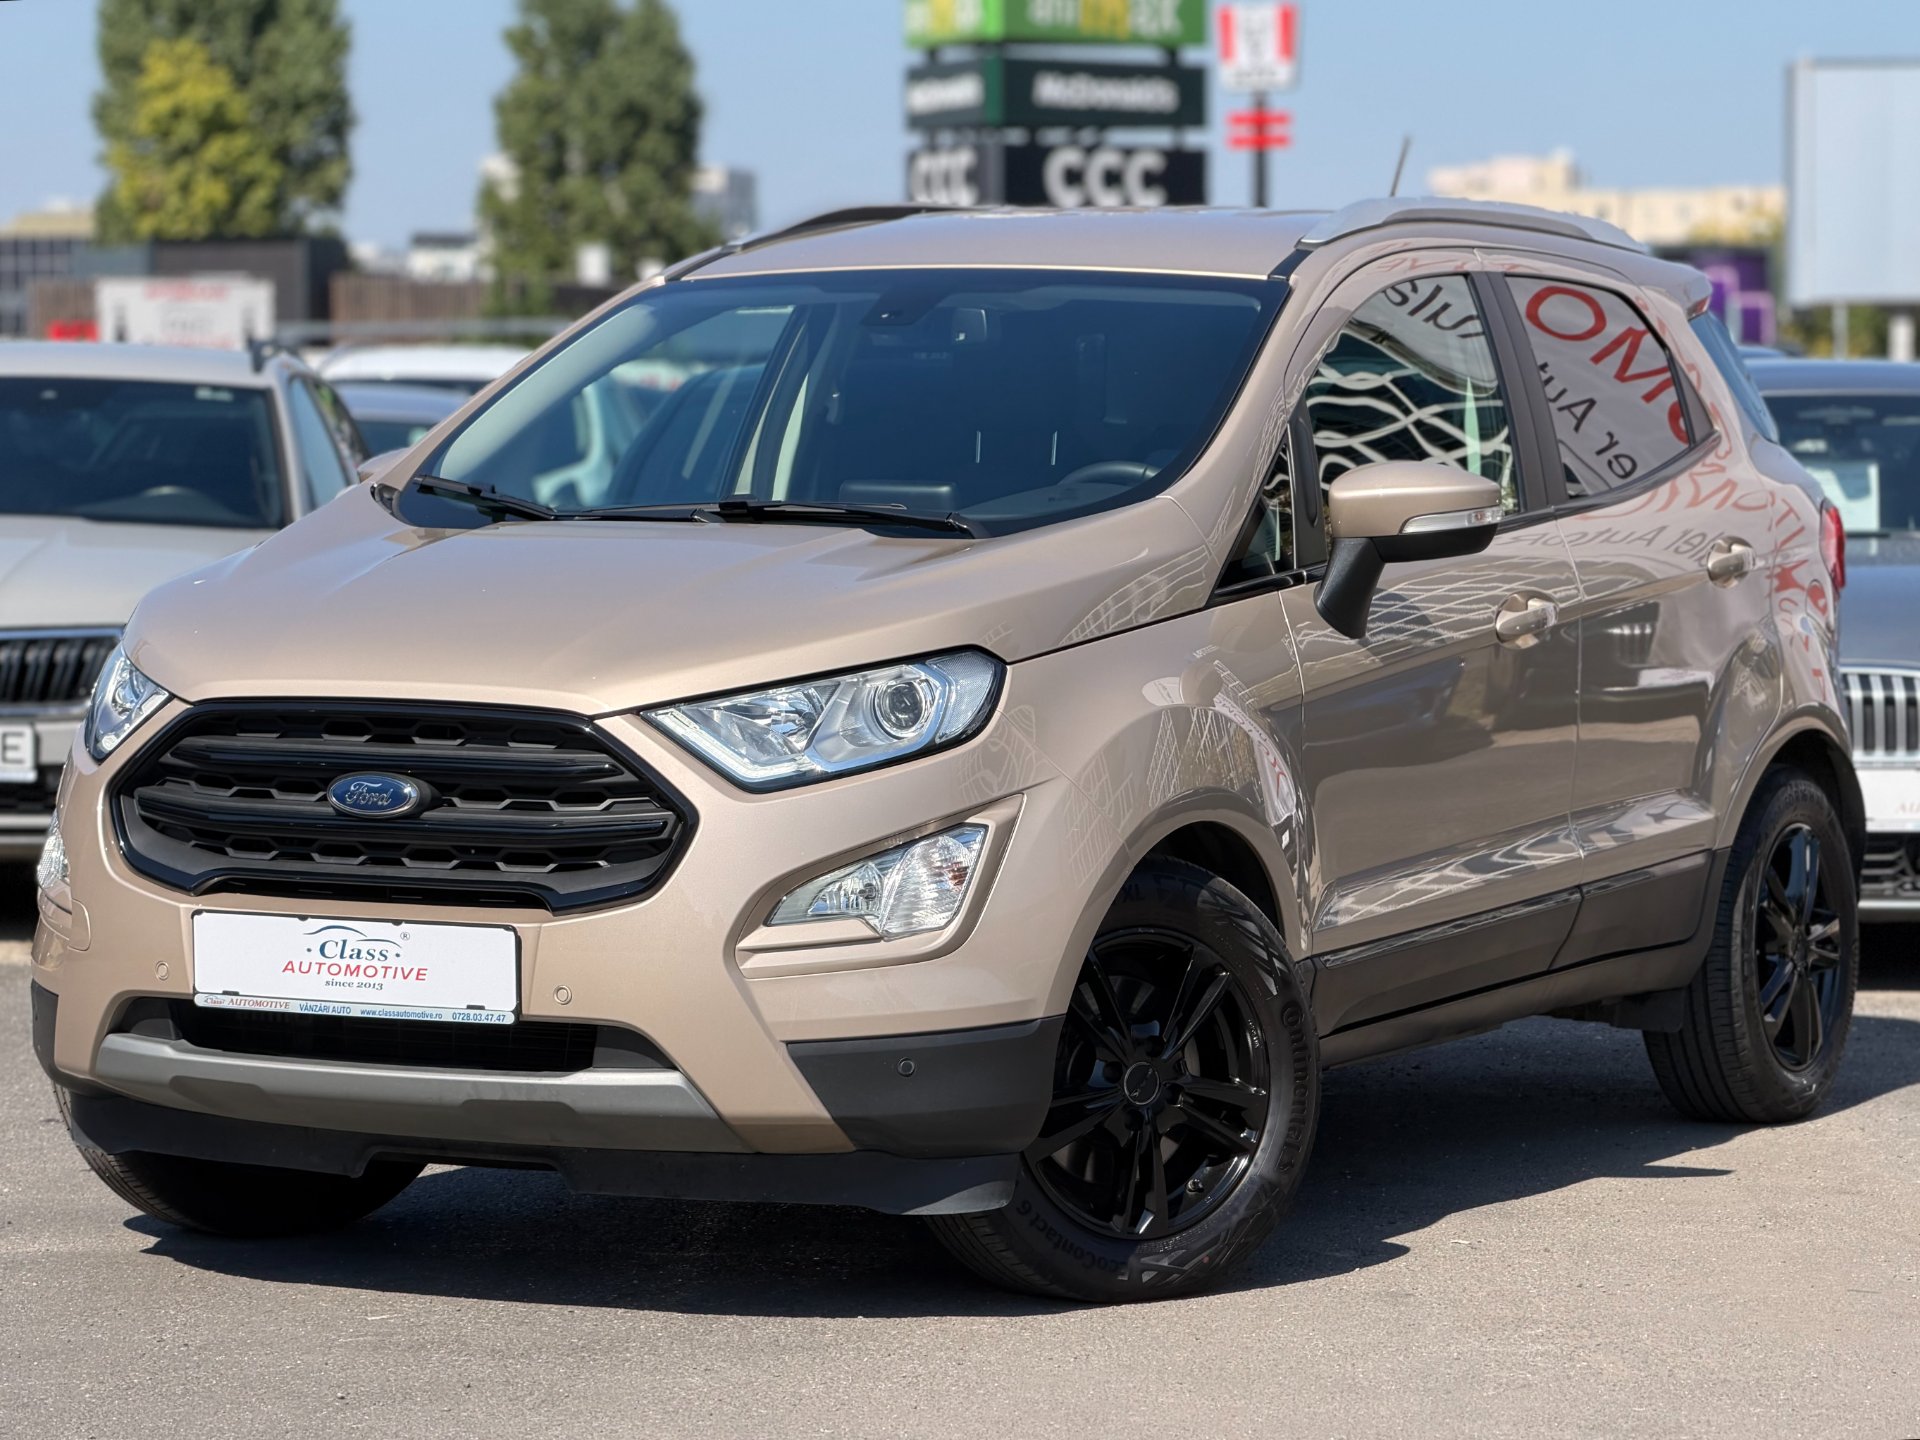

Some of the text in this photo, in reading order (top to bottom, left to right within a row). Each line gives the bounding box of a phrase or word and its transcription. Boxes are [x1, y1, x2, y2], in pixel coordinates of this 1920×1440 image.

[1043, 146, 1167, 207] CCC
[345, 781, 393, 806] Ford
[319, 939, 389, 962] Class
[282, 960, 428, 981] AUTOMOTIVE
[325, 979, 384, 991] since 2013
[228, 998, 290, 1010] AUTOMOTIVE
[331, 1006, 352, 1015] AUTO
[360, 1008, 443, 1020] www.classautomotive.ro
[452, 1012, 506, 1023] 0728.03.47.47
